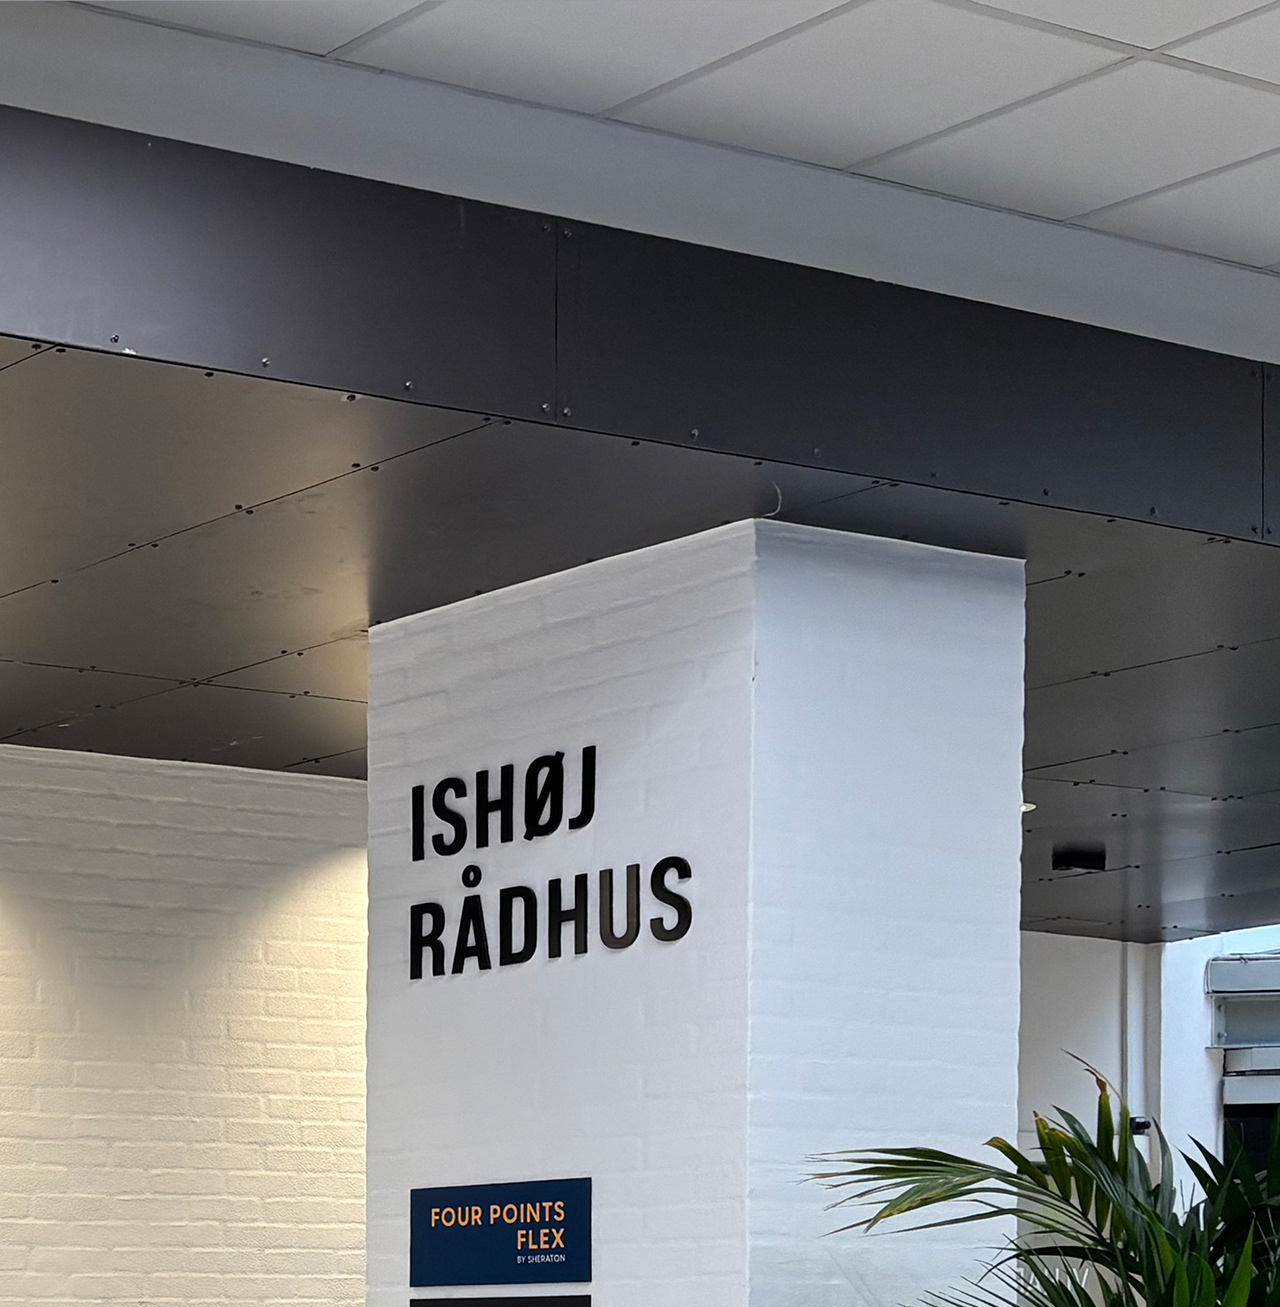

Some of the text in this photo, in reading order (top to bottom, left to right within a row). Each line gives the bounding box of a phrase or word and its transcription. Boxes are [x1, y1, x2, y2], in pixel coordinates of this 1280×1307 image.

[411, 745, 597, 861] ISHØJ
[409, 856, 693, 980] RÅDHUS
[432, 1201, 564, 1227] FOUR POINTS
[518, 1228, 564, 1250] FLEX
[528, 1255, 565, 1263] SHERATON
